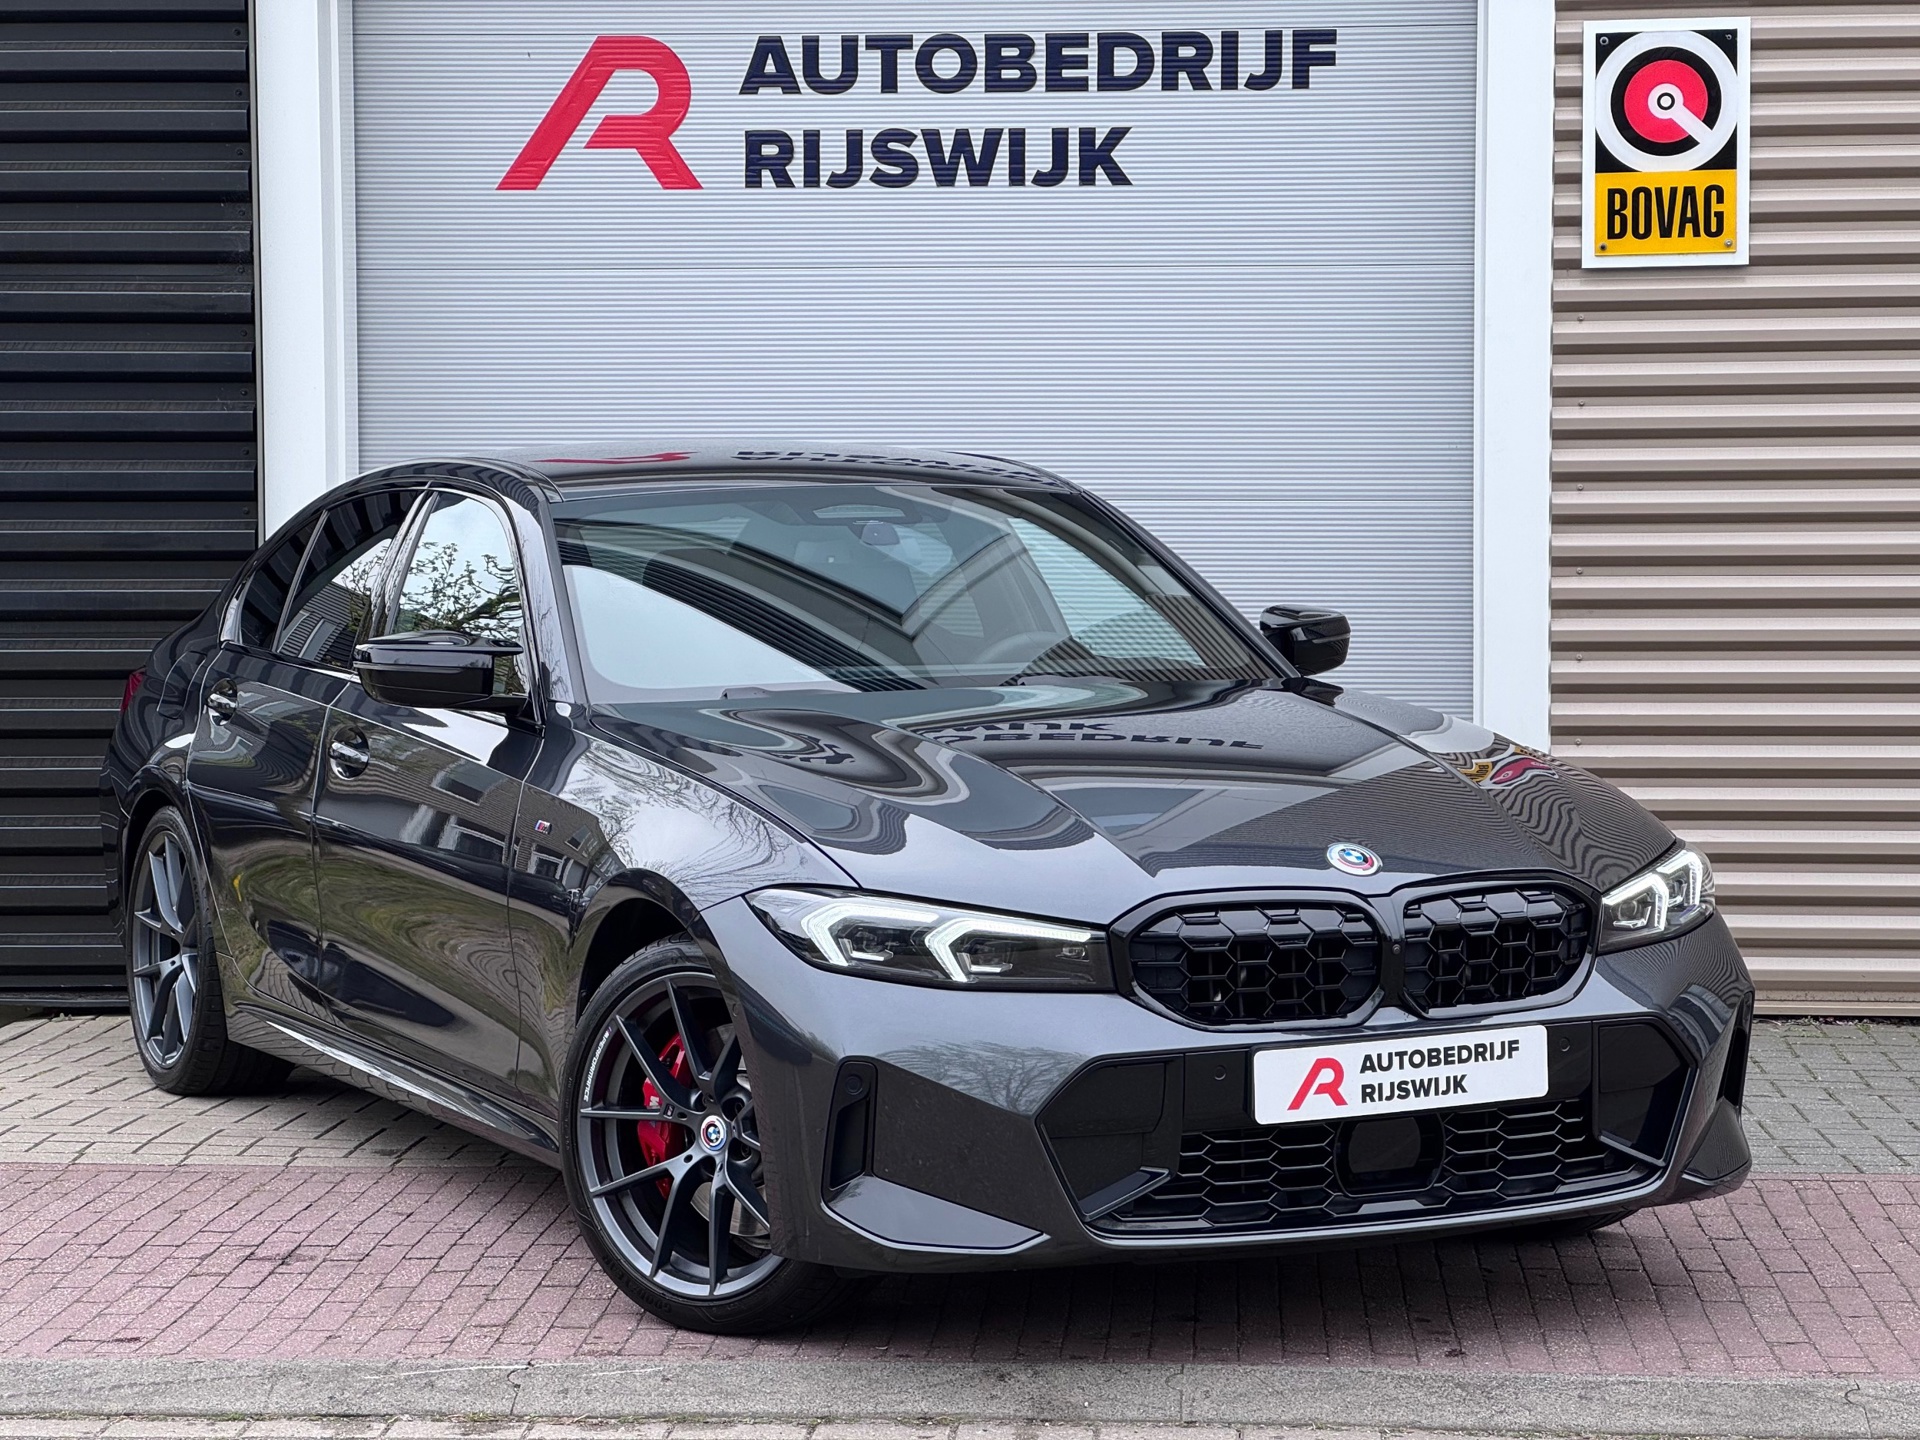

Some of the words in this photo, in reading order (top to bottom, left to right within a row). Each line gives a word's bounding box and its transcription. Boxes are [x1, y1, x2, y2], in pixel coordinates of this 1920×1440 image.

[738, 28, 1338, 96] AUTOBEDRIJF
[744, 127, 1134, 189] RIJSWIJK
[1606, 184, 1725, 240] BOVAG
[1360, 1039, 1520, 1074] AUTOBEDRIJF
[1361, 1074, 1468, 1104] RIJSWIJK
